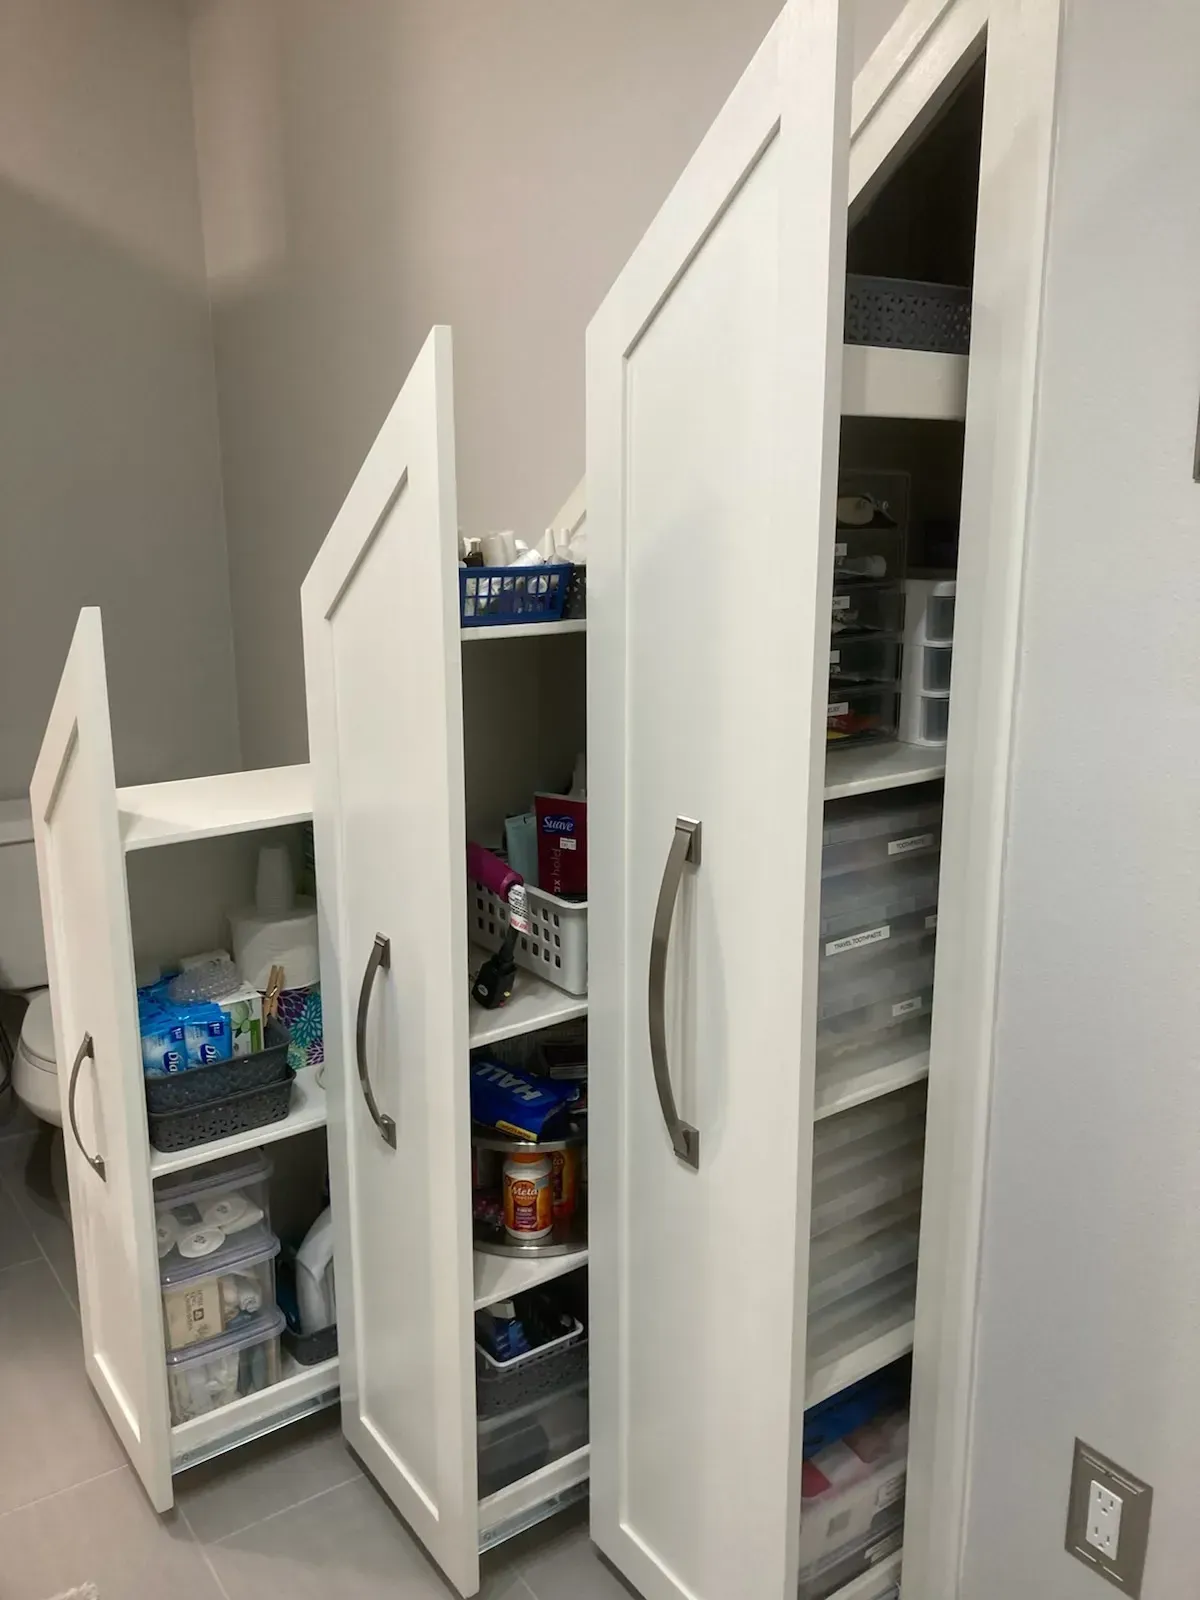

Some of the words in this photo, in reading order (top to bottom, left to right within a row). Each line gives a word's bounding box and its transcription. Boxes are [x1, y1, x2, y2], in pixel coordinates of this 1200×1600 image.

[543, 815, 574, 832] Suave
[550, 848, 561, 876] hold
[852, 931, 883, 944] TOOTHPASTE
[168, 1052, 178, 1073] Dia
[205, 1045, 217, 1064] Dia
[475, 1062, 543, 1101] HALL
[512, 1186, 538, 1196] Meta
